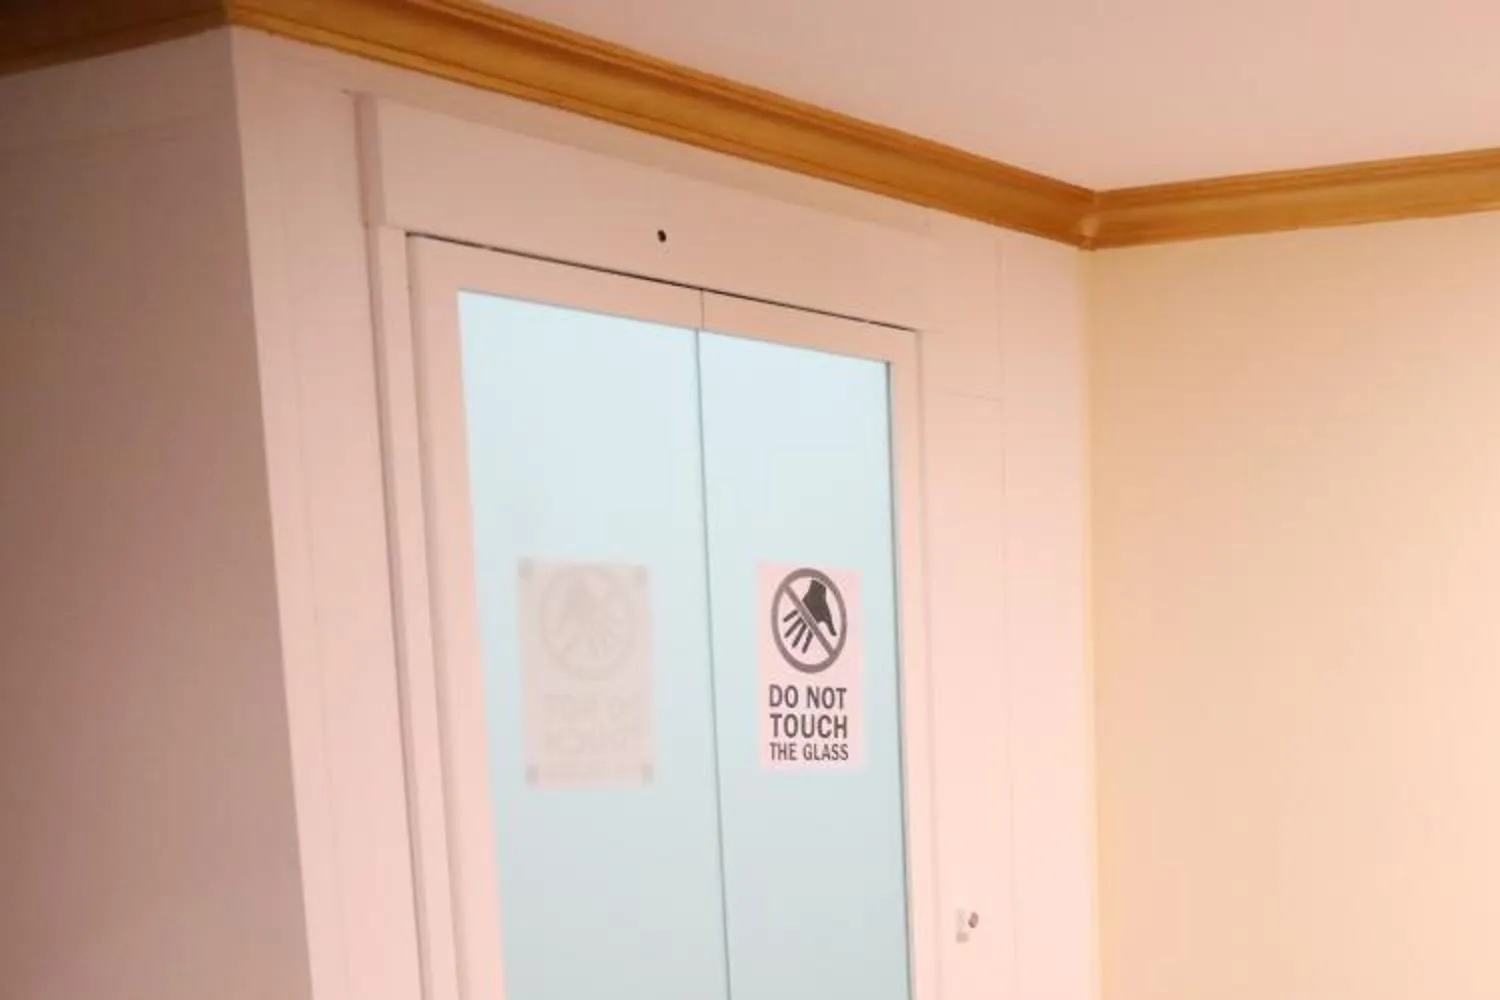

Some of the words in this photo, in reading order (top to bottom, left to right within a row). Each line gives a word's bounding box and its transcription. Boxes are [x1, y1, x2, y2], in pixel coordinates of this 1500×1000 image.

[769, 684, 798, 708] DO
[806, 686, 847, 709] NOT
[769, 713, 848, 738] TOUCH
[769, 742, 797, 761] THE
[802, 743, 849, 761] GLASS
